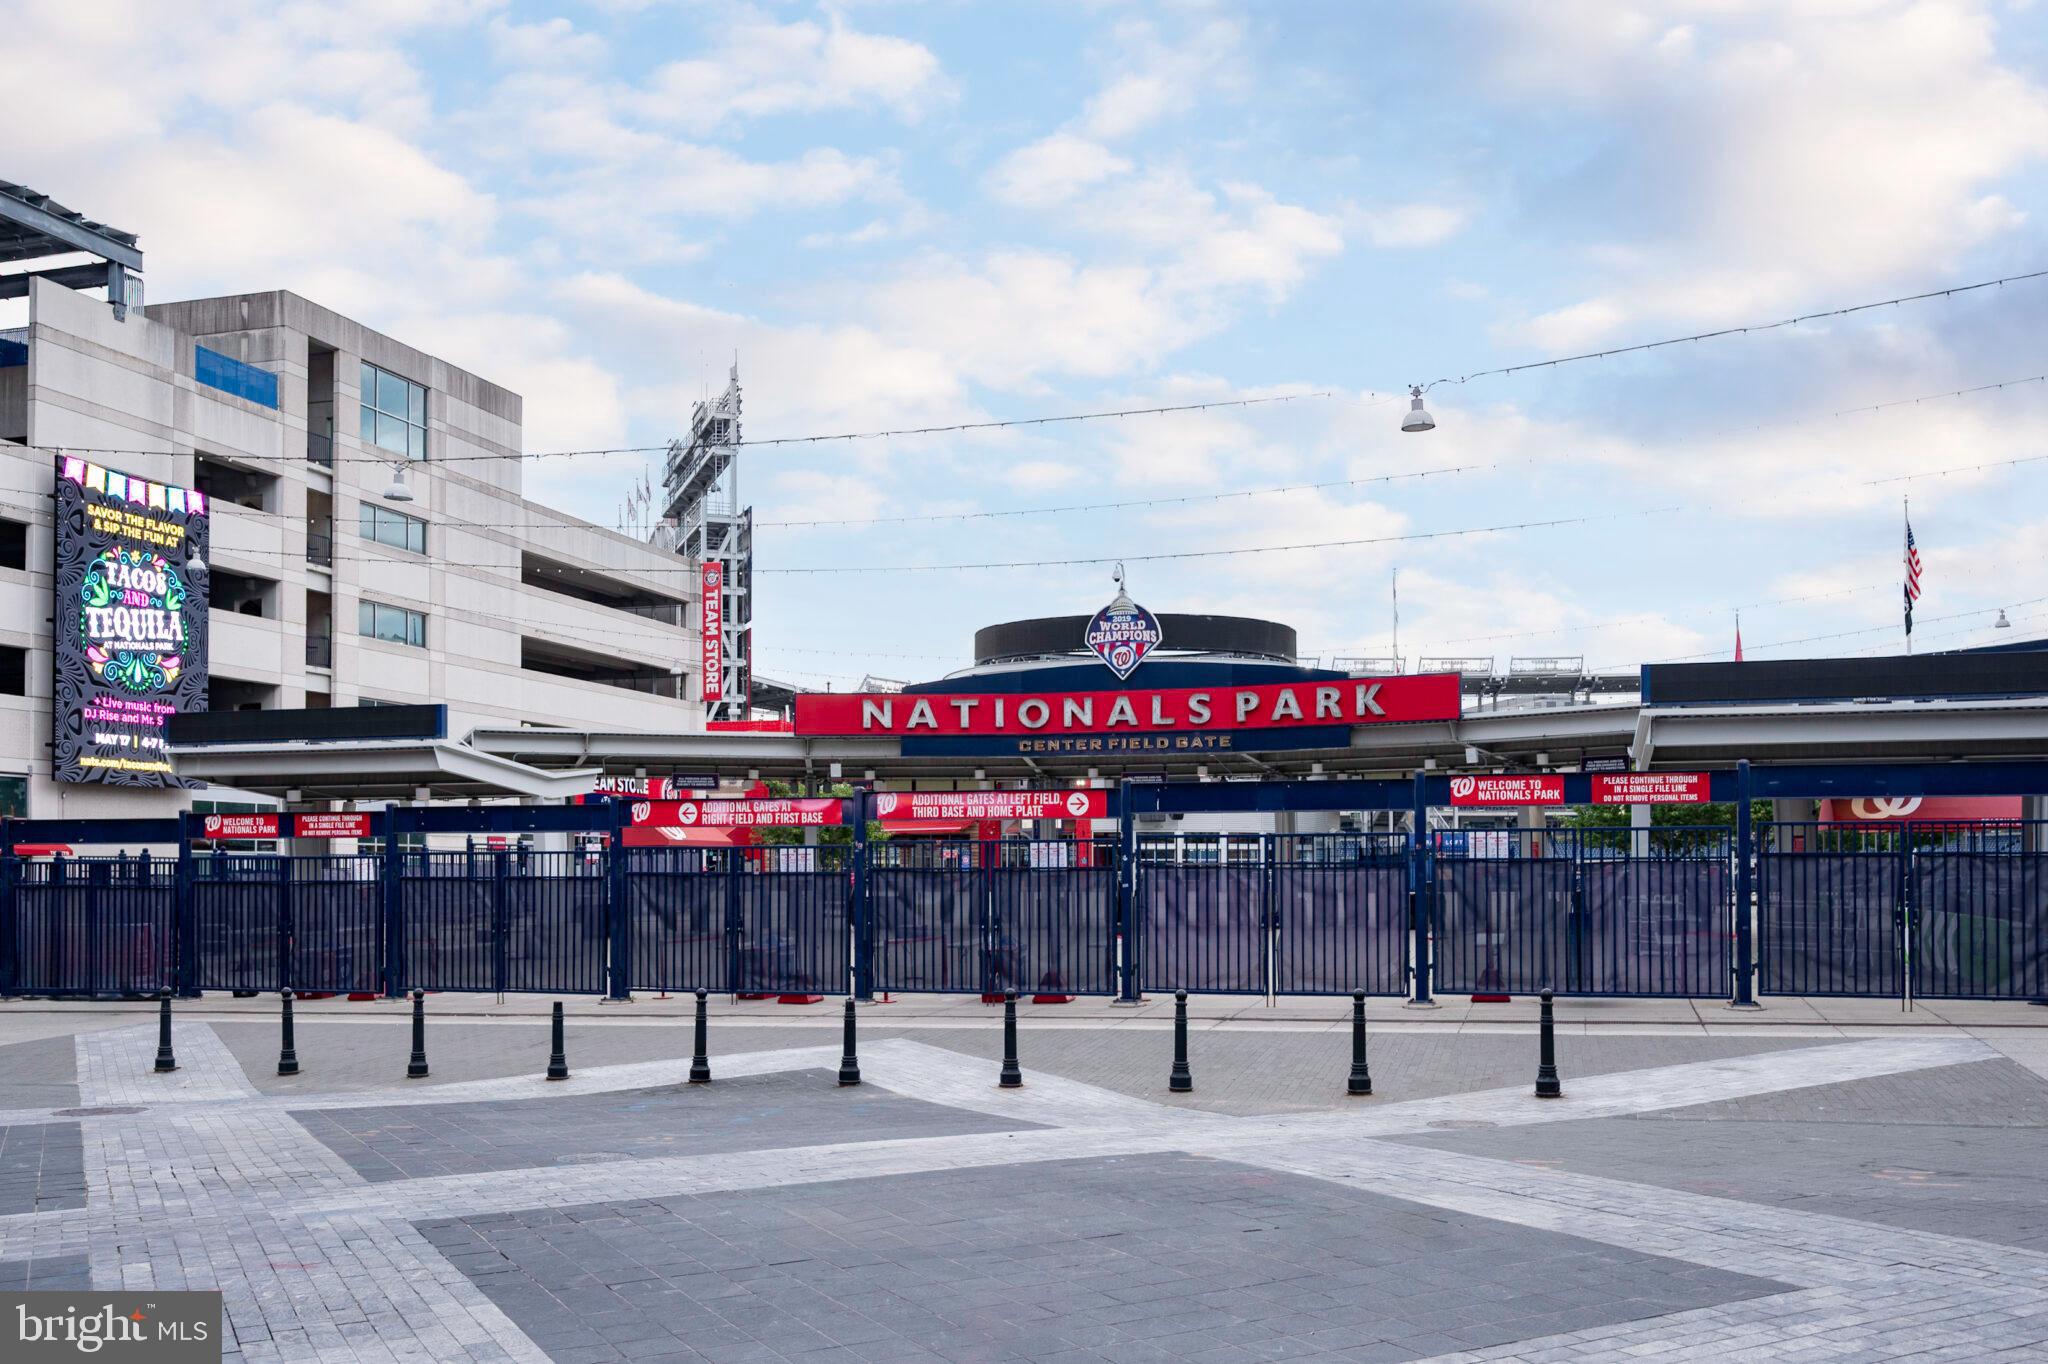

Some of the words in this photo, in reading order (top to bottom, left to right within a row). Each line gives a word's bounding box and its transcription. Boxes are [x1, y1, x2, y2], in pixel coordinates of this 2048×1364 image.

[88, 504, 122, 522] SAVOR
[125, 513, 144, 527] THE
[146, 519, 184, 537] FLAVOR
[94, 518, 102, 529] &
[103, 521, 120, 534] SIP
[121, 525, 141, 539] THE
[144, 531, 164, 544] FUN
[166, 536, 178, 548] AT
[105, 562, 166, 595] TACOS
[123, 590, 149, 607] AND
[706, 590, 718, 636] TEAM
[85, 607, 184, 641] TEQUILA
[1100, 620, 1146, 631] WORLD
[1089, 630, 1156, 644] CHAMPIONS
[103, 641, 113, 649] AT
[114, 641, 154, 650] NATIONALS
[155, 642, 174, 650] PARK
[706, 640, 719, 694] STORE
[103, 697, 122, 709] Live
[125, 701, 151, 712] music
[153, 703, 175, 714] from
[862, 694, 1212, 729] NATIONALS
[1236, 684, 1386, 723] PARK
[84, 708, 97, 719] DJ
[100, 710, 119, 721] Rise
[122, 713, 139, 723] and
[142, 714, 154, 725] Mr.
[157, 716, 163, 726] S
[95, 733, 118, 745] MAY
[119, 735, 131, 746] 17
[1019, 738, 1102, 752] CENTER
[1108, 736, 1169, 750] FIELD
[1176, 735, 1232, 748] GATE
[594, 777, 616, 792] EAM
[618, 777, 649, 795] STOE
[1478, 780, 1526, 790] WELCOME
[1529, 780, 1542, 789] TO
[1603, 776, 1628, 784] PLEASE
[1630, 776, 1663, 784] CONTINUE
[1478, 790, 1531, 800] NATIONALS
[1534, 789, 1560, 800] PARK
[1614, 785, 1621, 793] IN
[1655, 784, 1670, 792] FILE
[1672, 784, 1687, 792] LINE
[912, 794, 964, 806] ADDITIONAL
[967, 794, 994, 804] GATES
[997, 793, 1008, 804] AT
[1010, 793, 1032, 805] LEFT
[1034, 793, 1062, 806] FIELD,
[1625, 794, 1648, 802] REMOVE
[702, 802, 752, 813] ADDITIONAL
[753, 801, 779, 812] GATES
[781, 801, 792, 812] AT
[912, 806, 939, 817] THIRD
[942, 806, 964, 817] BASE
[966, 806, 985, 817] AND
[988, 806, 1013, 816] HOME
[1016, 805, 1043, 816] PLATE
[223, 818, 254, 826] WELCOME
[256, 818, 264, 826] TO
[702, 814, 728, 825] RIGHT
[729, 814, 753, 825] FIELD
[756, 813, 773, 824] AND
[776, 813, 800, 823] FIRST
[801, 812, 823, 823] BASE
[223, 826, 257, 834] NATIONALS
[258, 825, 276, 834] PARK
